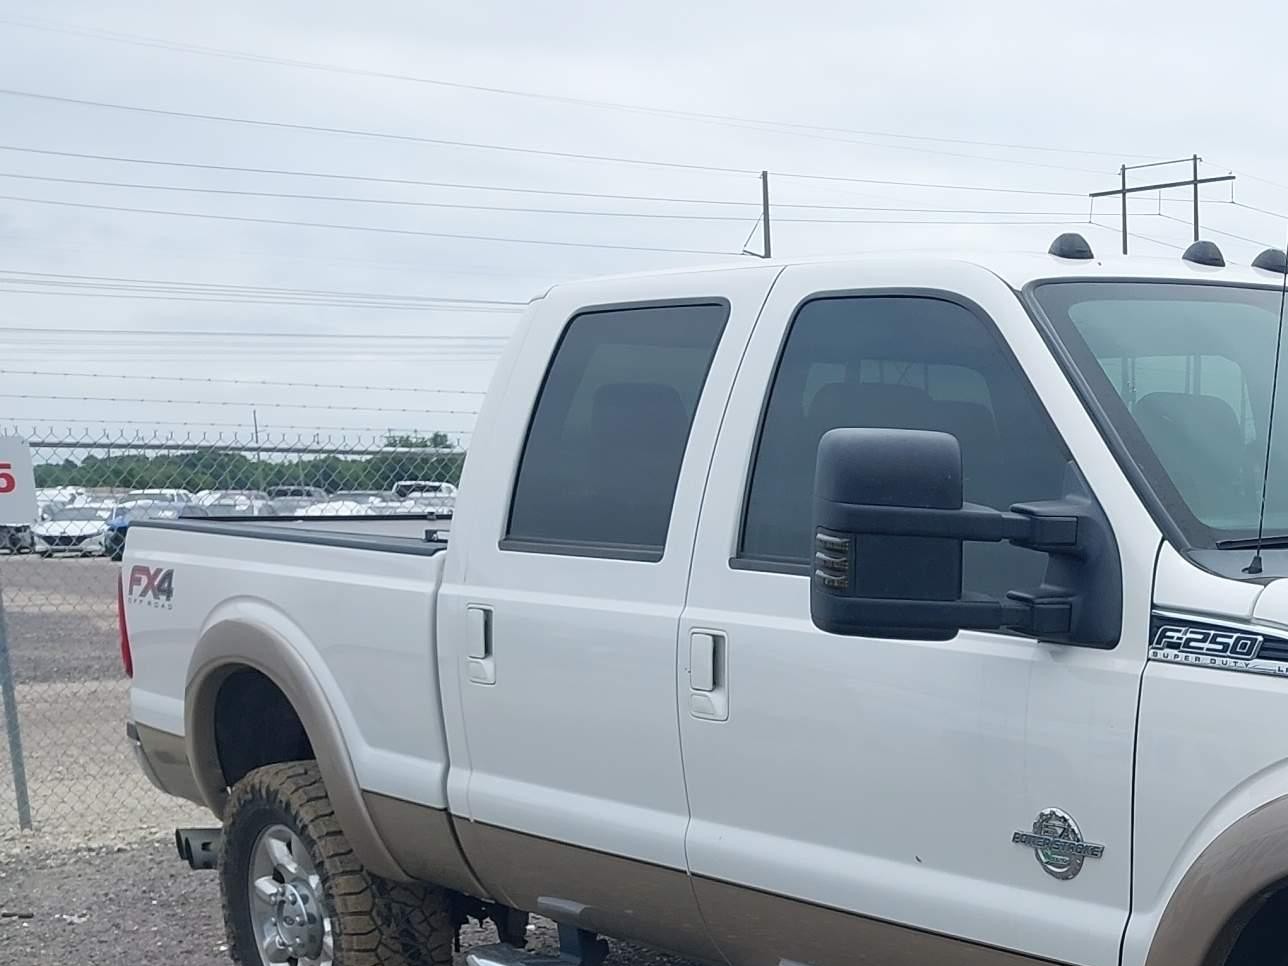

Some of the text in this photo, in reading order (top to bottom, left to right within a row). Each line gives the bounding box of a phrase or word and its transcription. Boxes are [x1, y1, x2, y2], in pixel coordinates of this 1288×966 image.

[127, 564, 174, 602] FX4
[1149, 625, 1263, 659] F-250
[1151, 650, 1251, 669] SUPER DUTY
